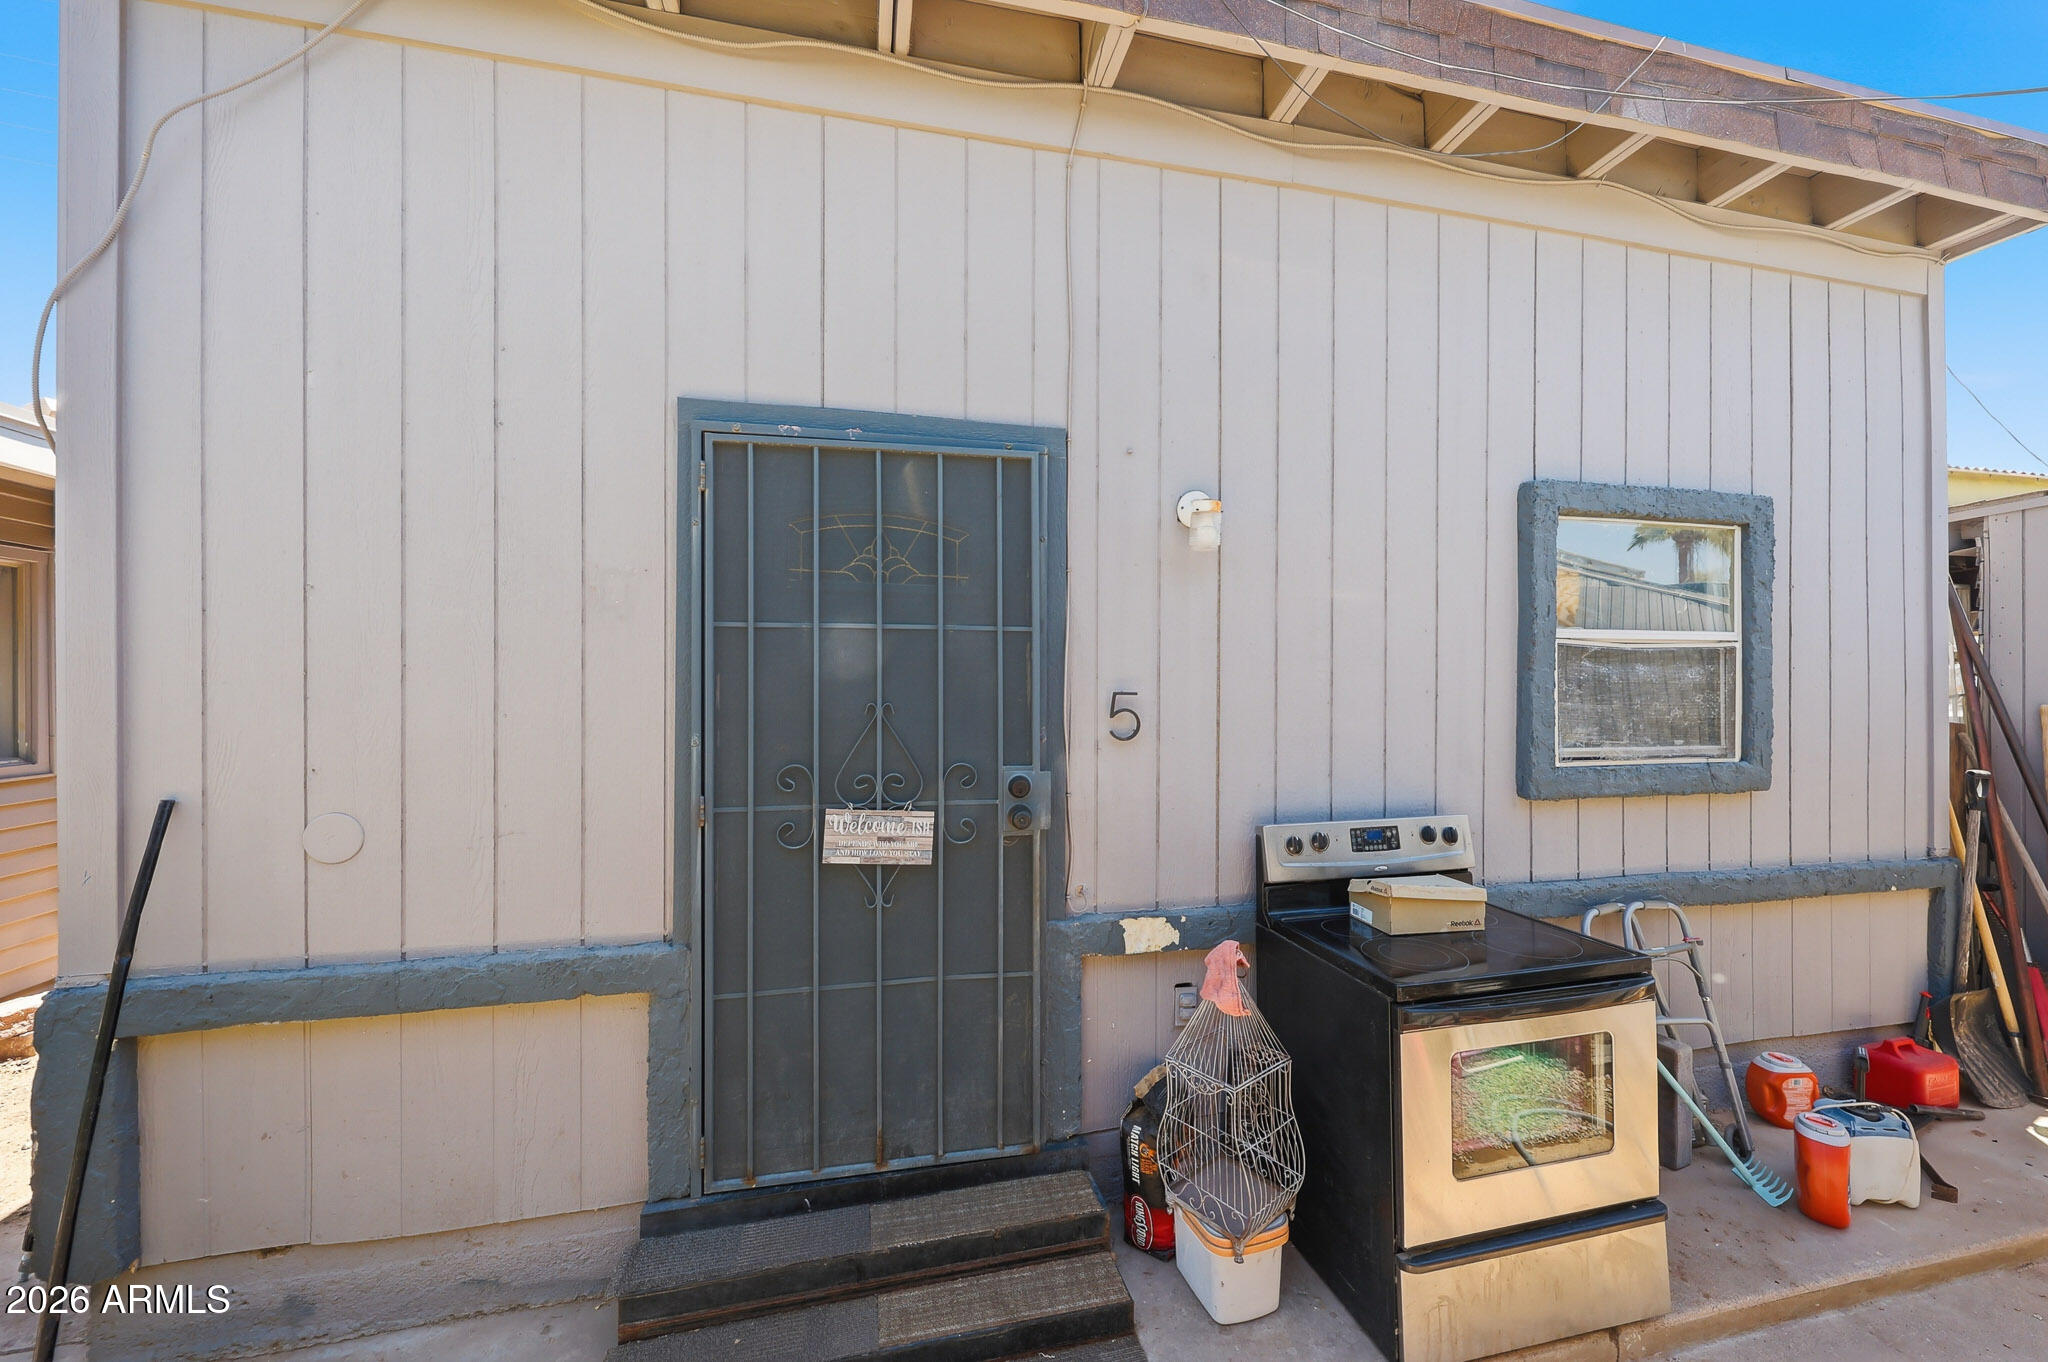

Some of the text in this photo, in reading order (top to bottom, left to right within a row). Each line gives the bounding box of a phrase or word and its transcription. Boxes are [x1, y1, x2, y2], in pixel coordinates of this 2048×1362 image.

[1109, 691, 1141, 741] 5
[829, 812, 931, 836] Welcome ISH
[888, 849, 903, 857] YOU
[1130, 1124, 1142, 1186] MATCH LIGHT
